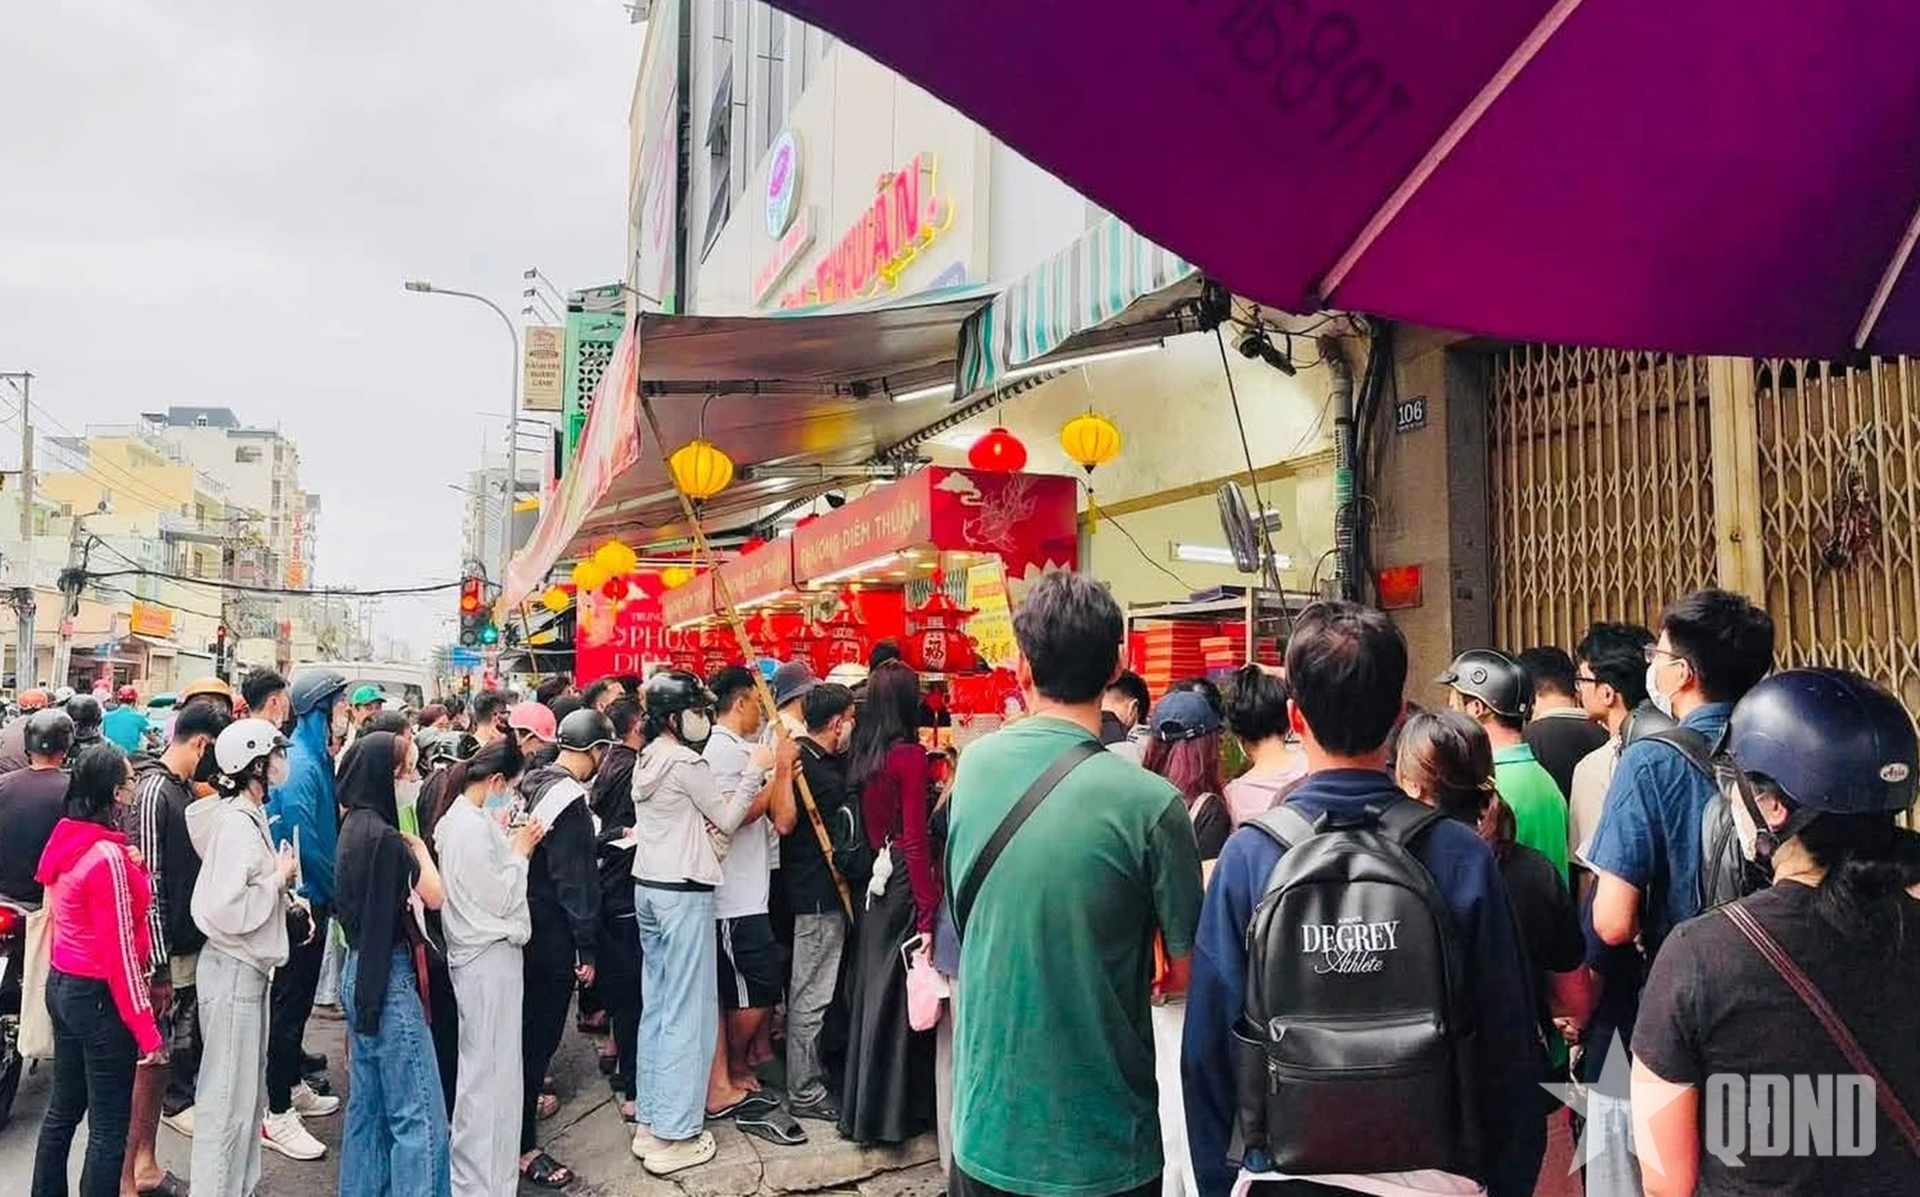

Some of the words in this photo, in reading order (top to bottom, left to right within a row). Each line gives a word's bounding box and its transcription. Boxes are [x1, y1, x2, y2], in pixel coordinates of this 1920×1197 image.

[1398, 400, 1423, 425] 106
[1301, 920, 1400, 953] DEGREY
[1314, 945, 1384, 974] Athlete
